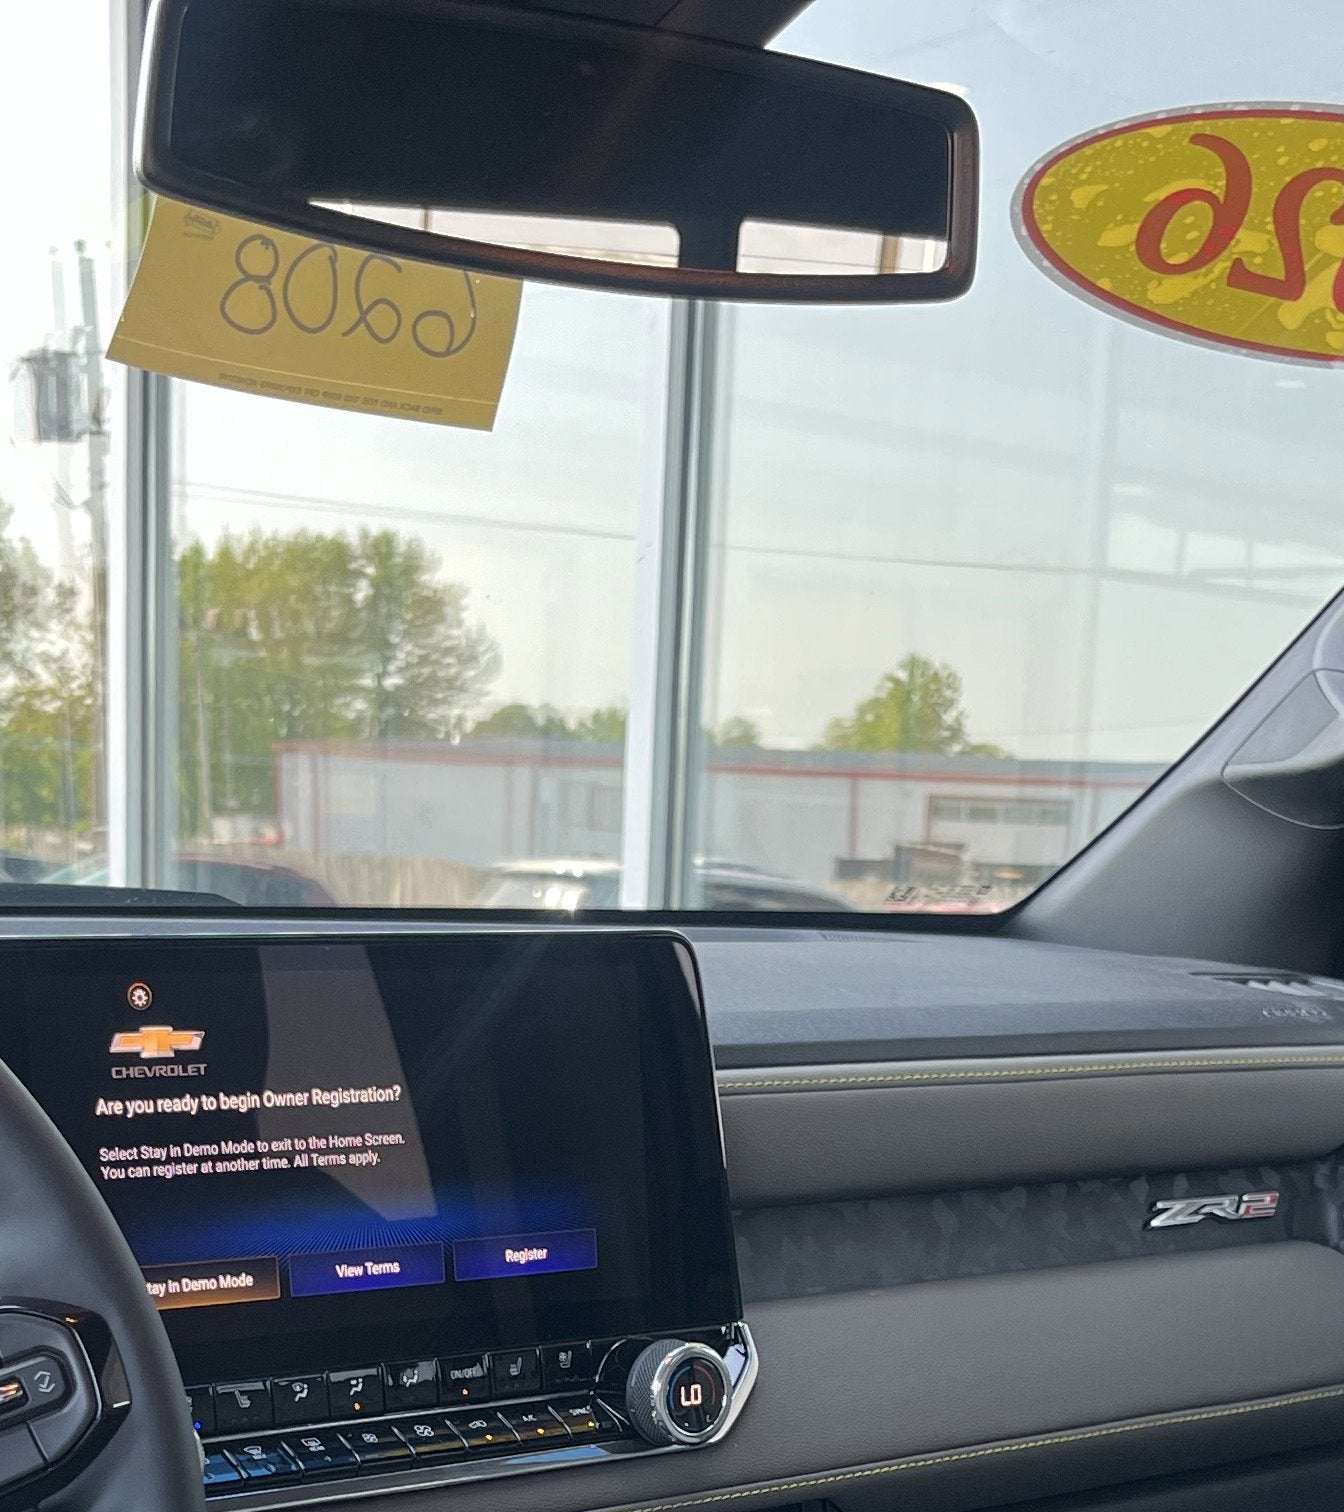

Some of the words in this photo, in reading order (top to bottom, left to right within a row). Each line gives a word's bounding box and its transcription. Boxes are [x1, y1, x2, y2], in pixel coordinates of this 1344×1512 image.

[111, 1063, 208, 1079] CHEVROLET
[95, 1096, 124, 1116] Are
[126, 1099, 154, 1118] you
[157, 1092, 199, 1115] ready
[201, 1094, 217, 1111] to
[219, 1091, 260, 1113] begin
[262, 1089, 309, 1108] Owner
[311, 1084, 402, 1108] Registration?
[99, 1146, 138, 1162] Select
[140, 1144, 167, 1161] Stay
[169, 1143, 182, 1158] in
[183, 1142, 219, 1157] Demo
[221, 1139, 255, 1155] Mode
[256, 1139, 269, 1153] to
[271, 1137, 293, 1152] exit
[294, 1137, 307, 1151] to
[308, 1135, 327, 1150] the
[329, 1134, 363, 1149] Home
[364, 1132, 406, 1147] Screen.
[100, 1165, 126, 1180] You
[127, 1165, 150, 1179] can
[152, 1161, 199, 1179] register
[200, 1160, 213, 1174] at
[215, 1157, 259, 1174] another
[262, 1156, 291, 1170] time.
[293, 1153, 309, 1168] All
[310, 1152, 347, 1167] Terms
[348, 1150, 381, 1166] apply.
[1146, 1190, 1280, 1230] ZR2
[505, 1246, 548, 1264] Register
[335, 1263, 363, 1279] View
[364, 1261, 400, 1277] Terms
[146, 1281, 167, 1298] tay
[168, 1279, 181, 1293] in
[181, 1277, 218, 1292] Demo
[218, 1273, 254, 1290] Mode
[680, 1383, 702, 1406] LO
